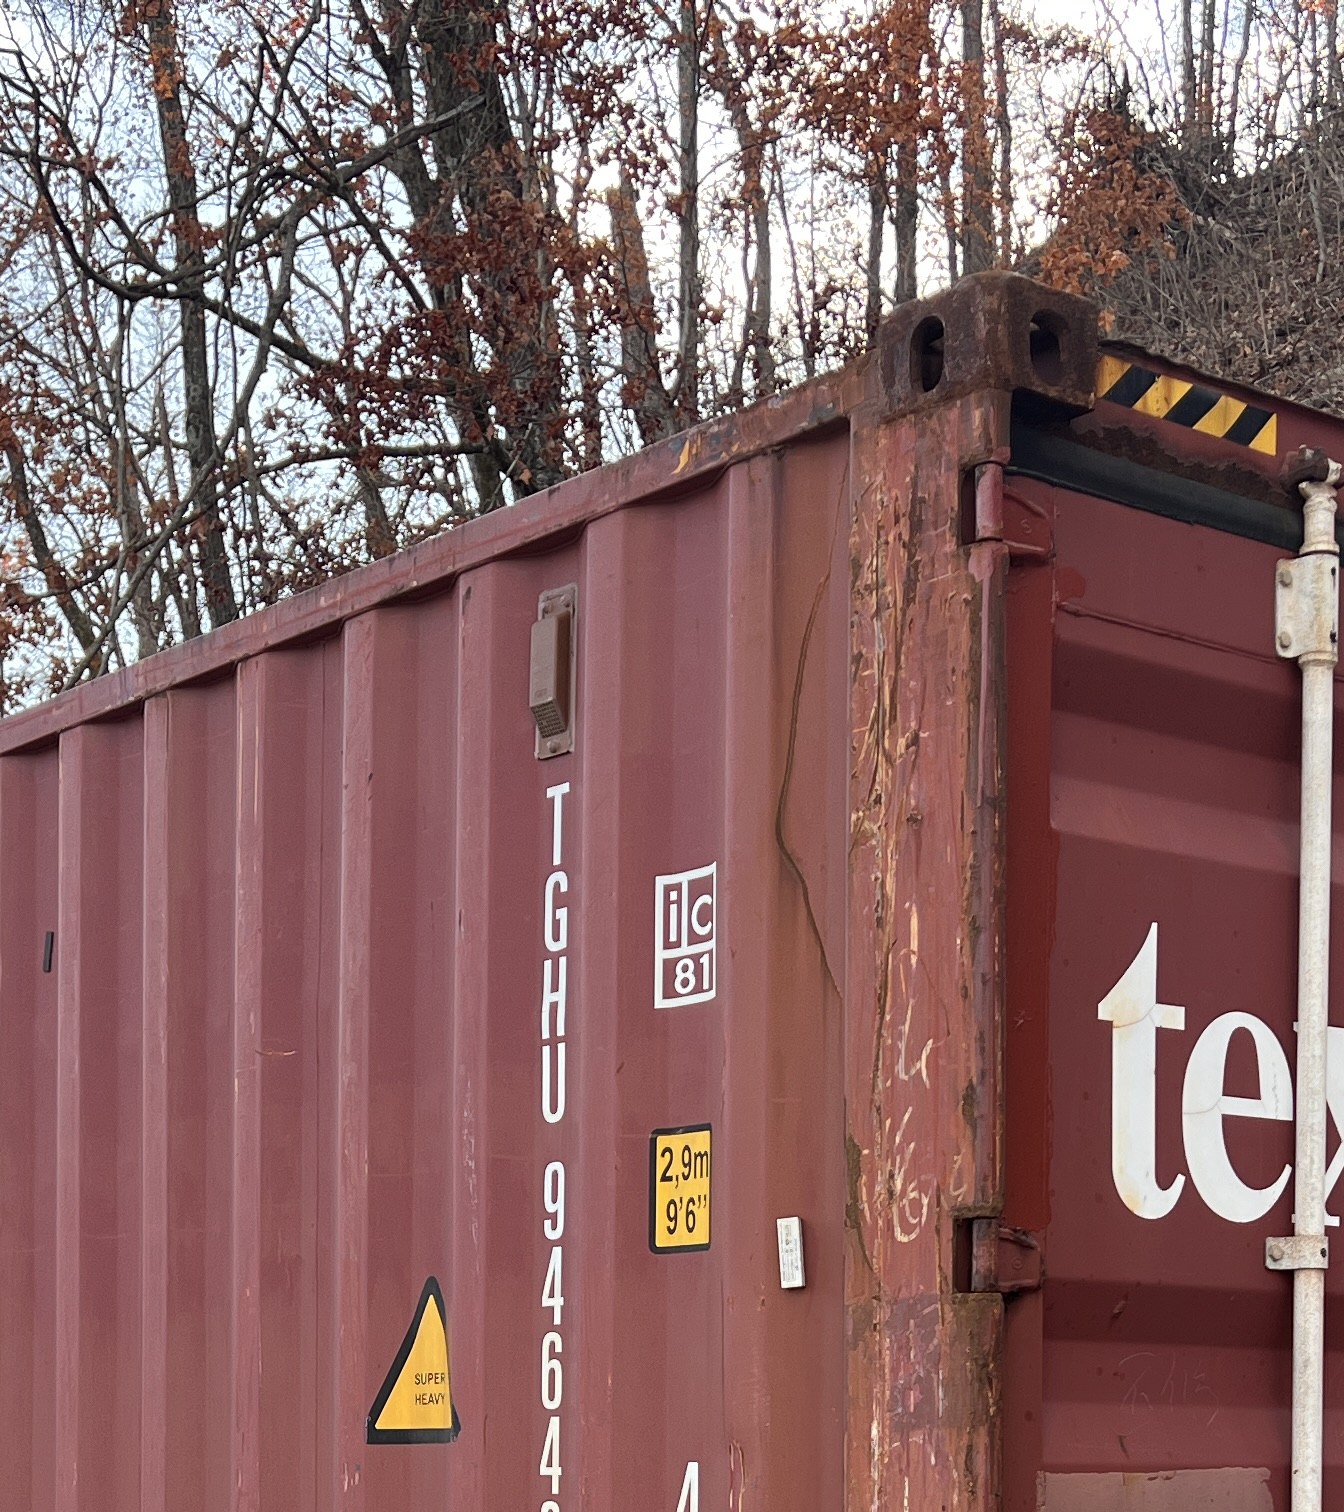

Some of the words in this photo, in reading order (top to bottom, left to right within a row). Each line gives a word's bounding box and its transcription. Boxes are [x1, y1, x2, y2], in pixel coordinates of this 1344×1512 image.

[542, 782, 570, 1124] TGHU
[674, 953, 710, 994] 81
[414, 1372, 446, 1386] SUPER
[414, 1393, 446, 1406] HEAVY
